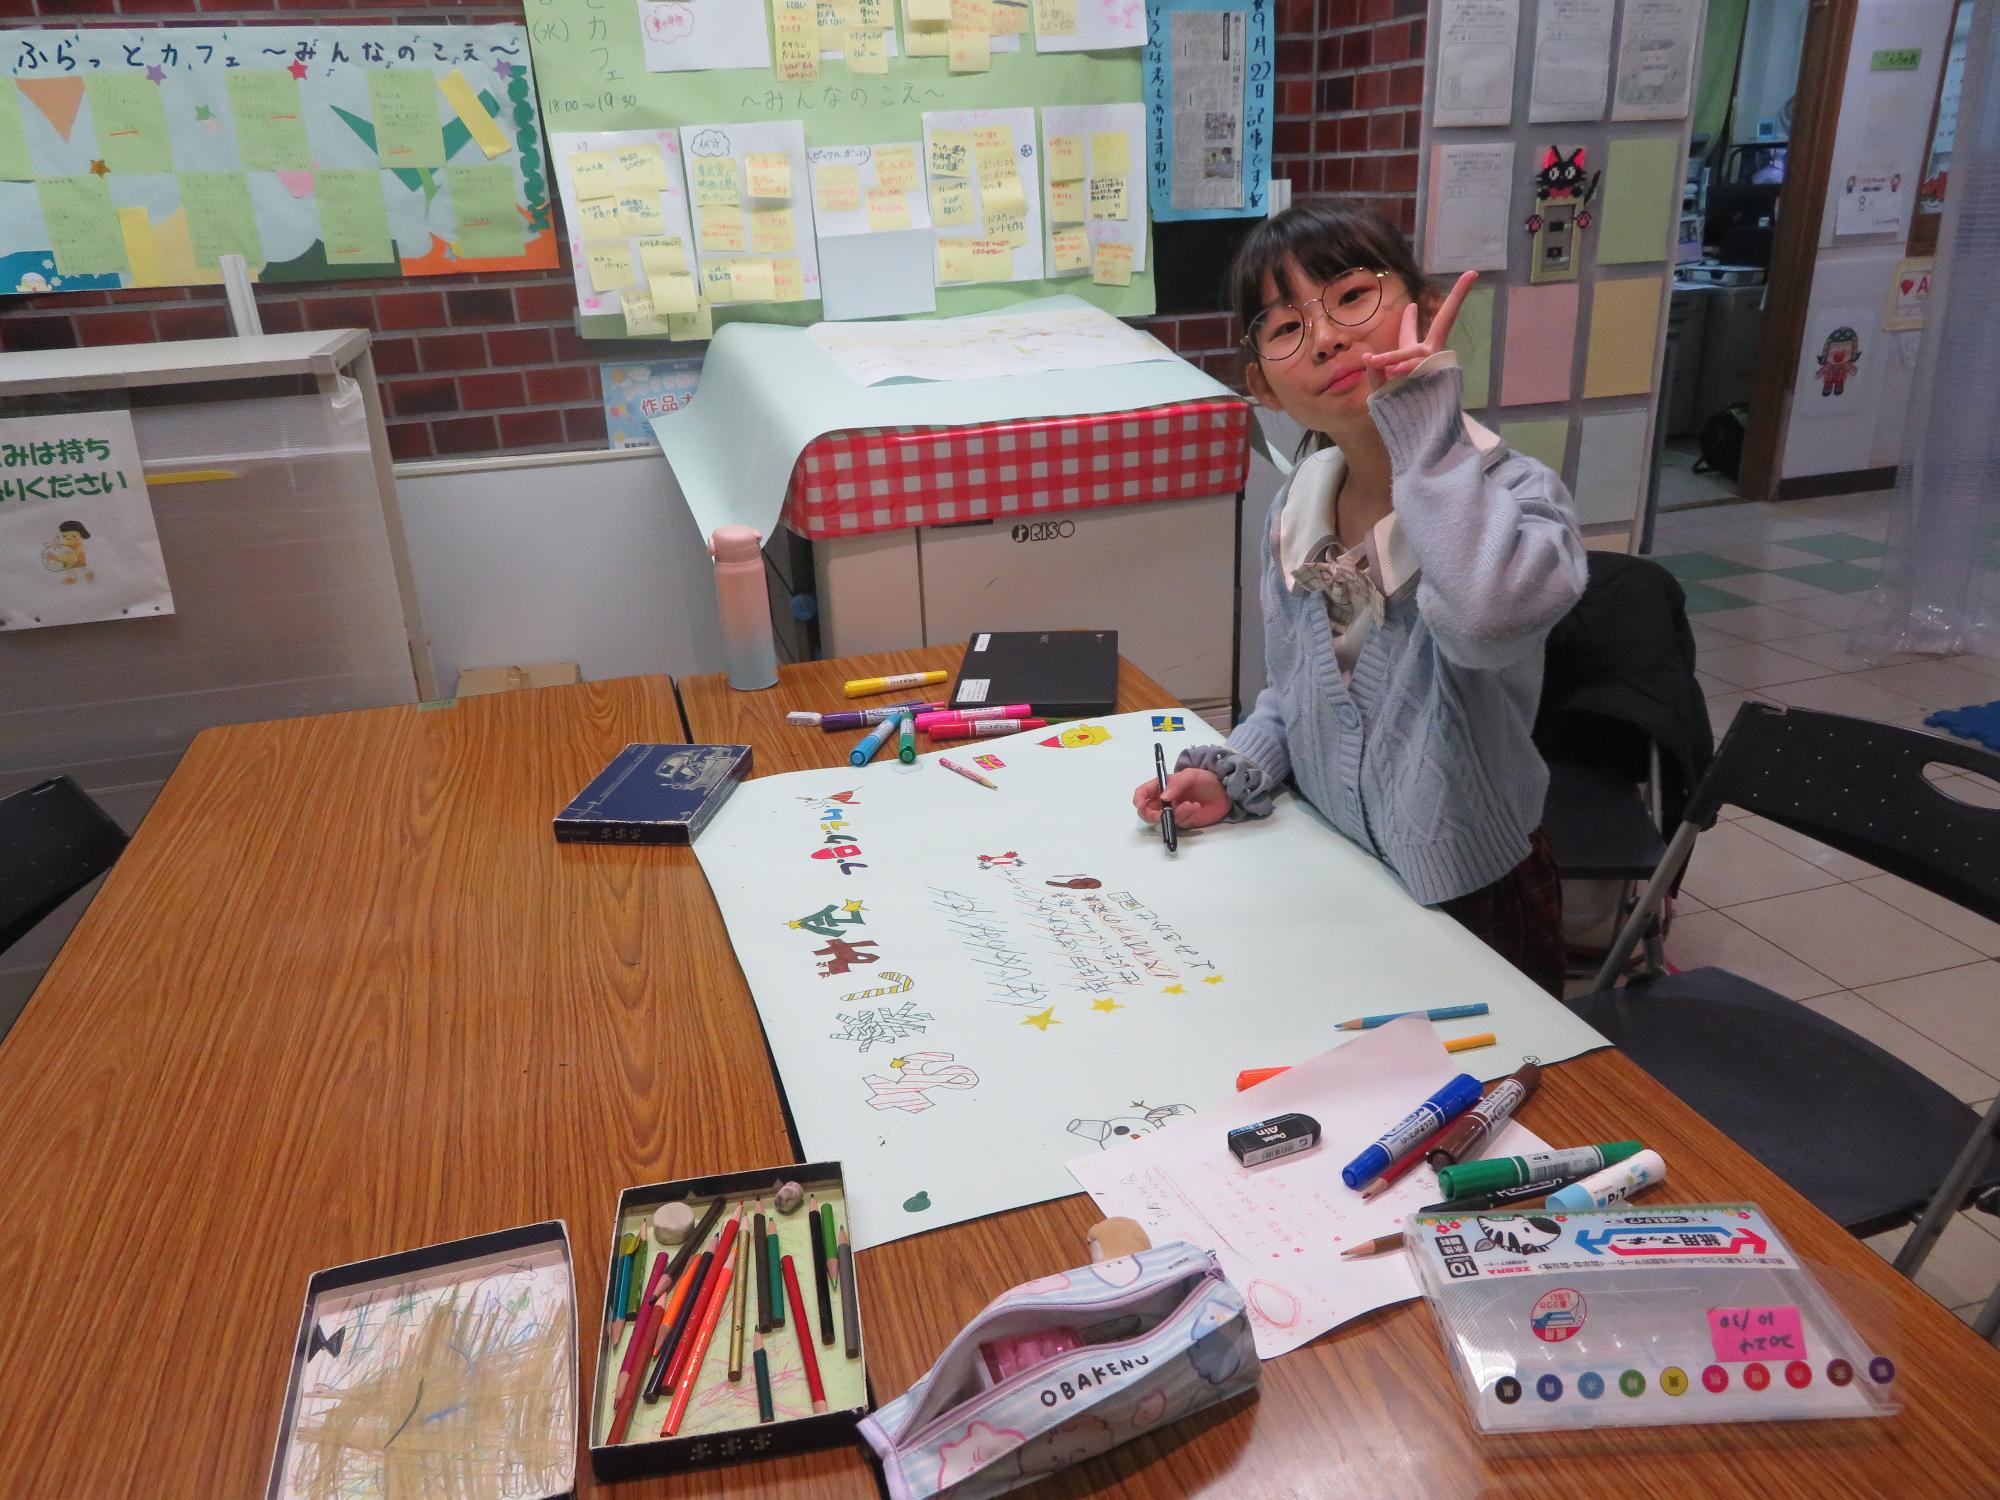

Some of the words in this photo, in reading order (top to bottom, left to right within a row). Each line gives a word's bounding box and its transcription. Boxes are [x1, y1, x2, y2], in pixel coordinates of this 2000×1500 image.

[0, 438, 111, 467] みは持ち
[0, 470, 128, 501] りください
[1029, 520, 1075, 541] RISO
[1255, 1125, 1279, 1137] Ain
[1261, 1131, 1287, 1143] Pentel
[1615, 1231, 1721, 1247] 紙用マッキー
[1449, 1262, 1477, 1277] 10
[1487, 1265, 1532, 1275] ZEBRA
[1039, 1353, 1150, 1408] OBAKENU
